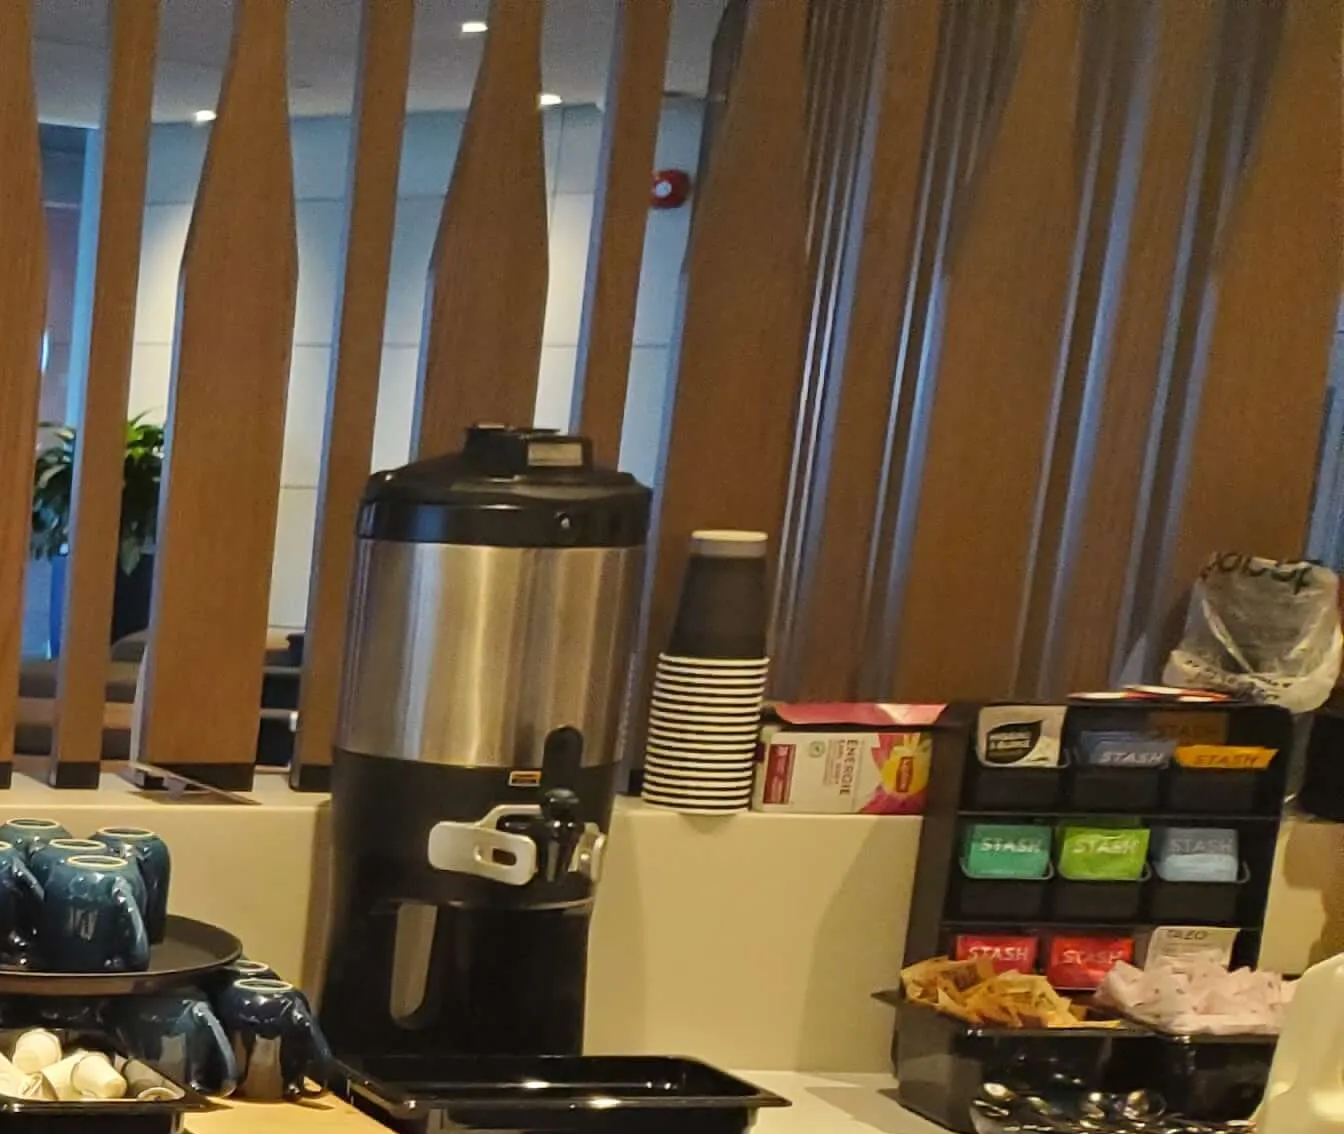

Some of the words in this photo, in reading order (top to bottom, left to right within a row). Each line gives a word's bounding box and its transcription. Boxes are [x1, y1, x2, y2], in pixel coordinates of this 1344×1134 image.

[1098, 751, 1166, 764] STASH
[1194, 754, 1259, 766] STASH
[979, 838, 1042, 853] STASH
[1072, 839, 1140, 854] STASH
[1169, 838, 1233, 854] STASH
[968, 946, 1029, 961] STASH
[1063, 949, 1125, 964] STASH
